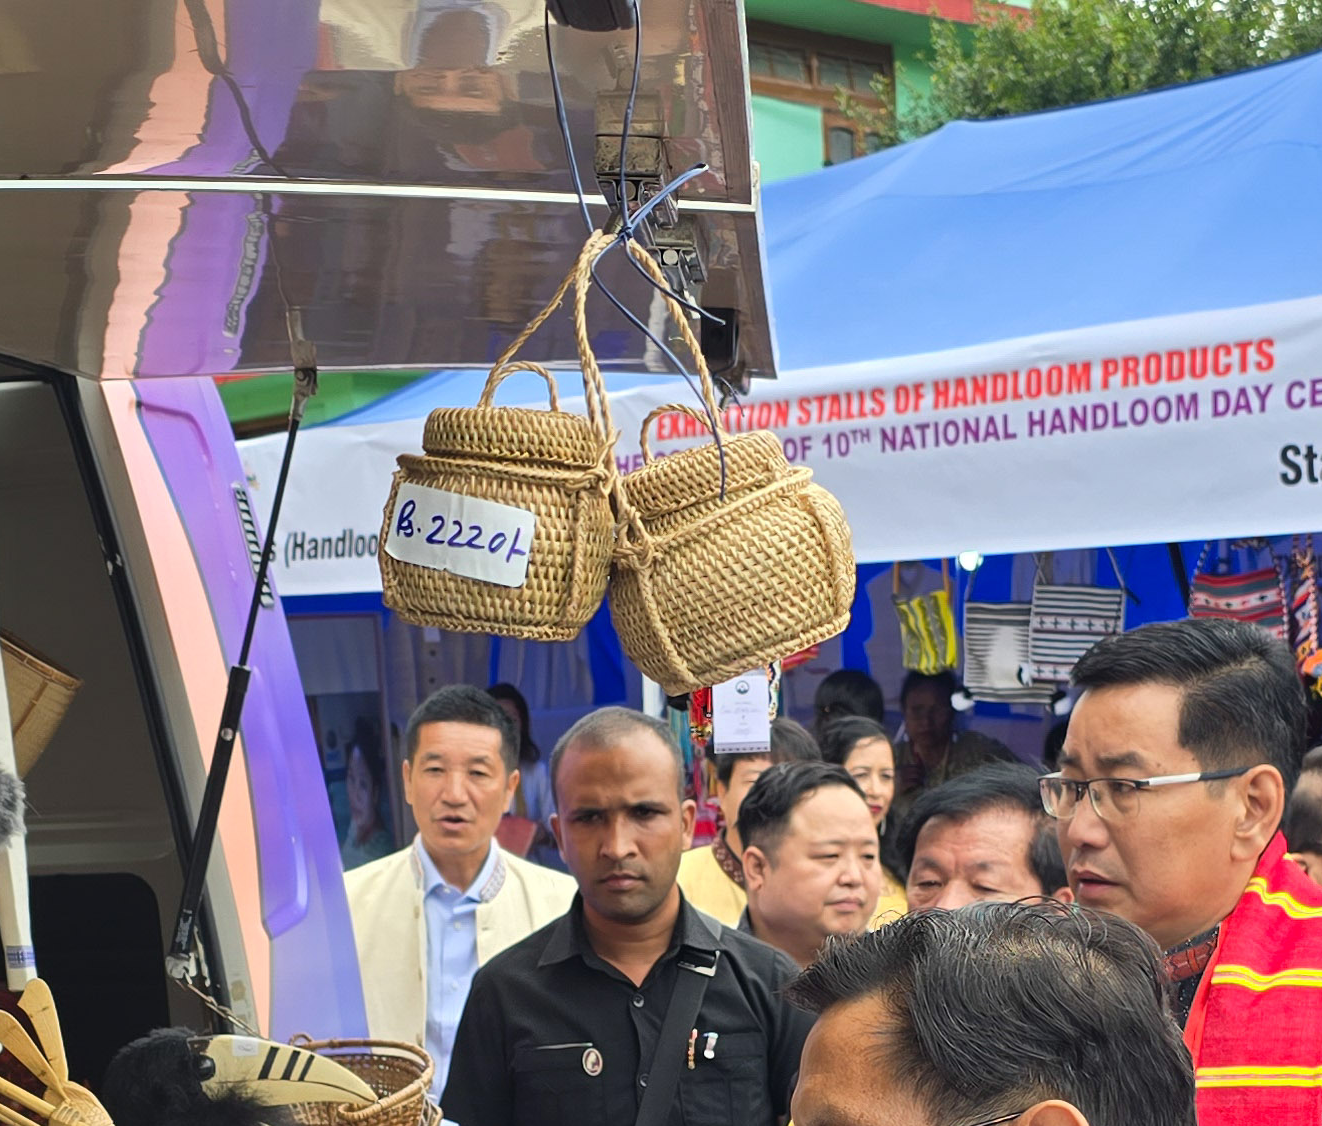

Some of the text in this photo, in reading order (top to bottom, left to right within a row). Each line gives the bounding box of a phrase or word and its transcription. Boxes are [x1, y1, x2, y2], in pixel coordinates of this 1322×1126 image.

[782, 435, 812, 463] OF
[822, 429, 871, 457] 10TH
[879, 414, 1018, 451] NATIONAL
[1027, 393, 1200, 437] HANDLOOM
[1211, 382, 1274, 419] DAY
[796, 386, 888, 427] STALLS
[893, 382, 927, 416] OF
[932, 360, 1093, 411] HANDLOOM
[1100, 337, 1276, 391] PRODUCTS
[285, 527, 379, 569] (Handloo
